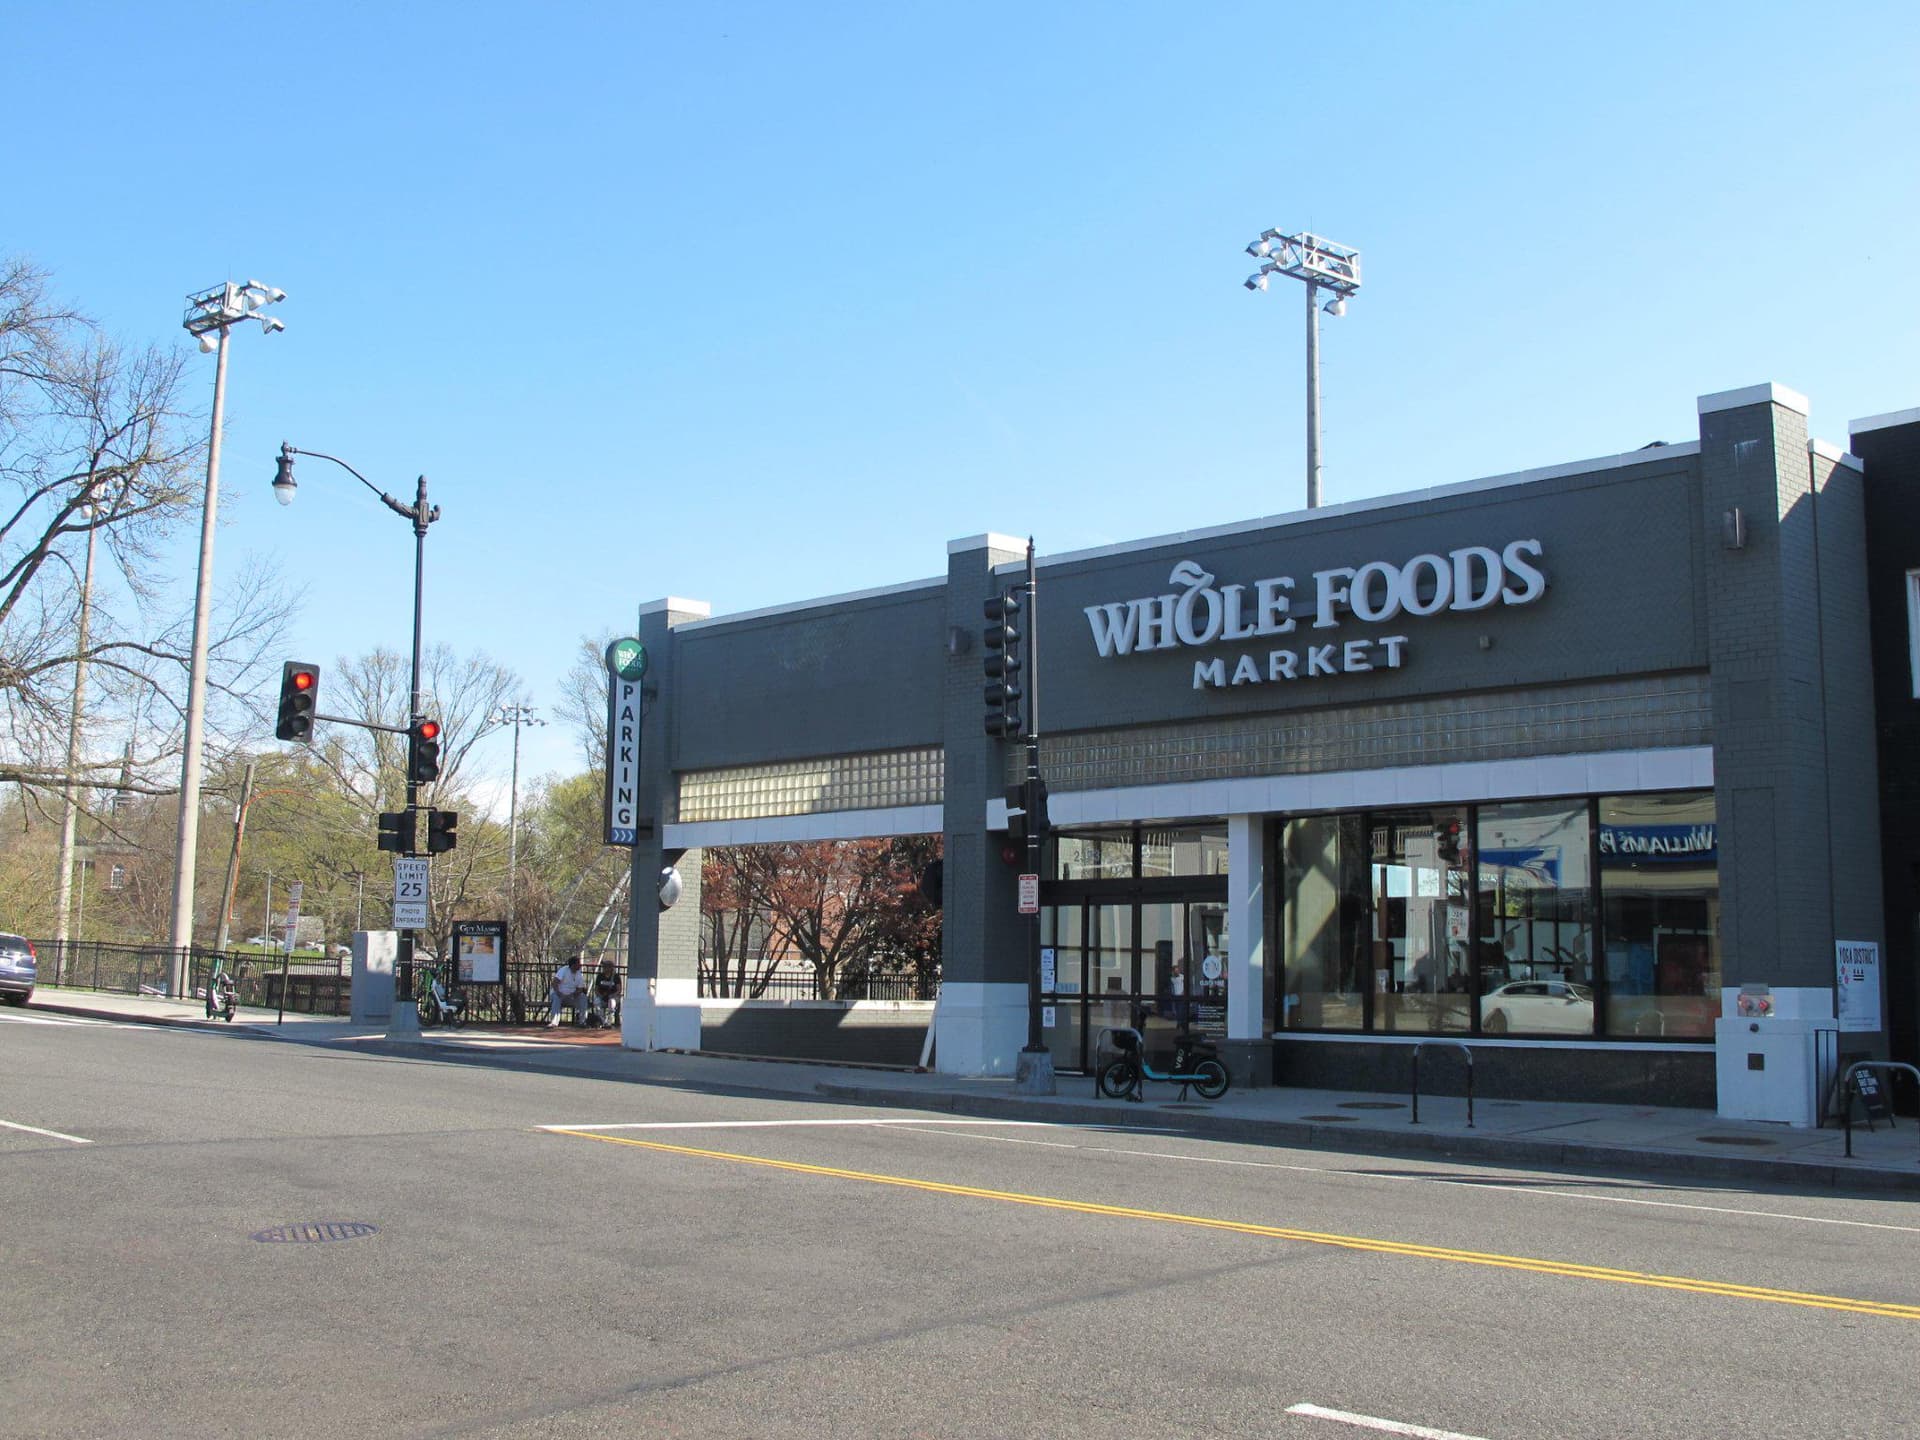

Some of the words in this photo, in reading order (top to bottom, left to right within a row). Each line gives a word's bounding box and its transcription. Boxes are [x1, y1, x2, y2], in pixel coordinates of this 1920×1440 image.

[1083, 561, 1296, 658] WHOLE
[1312, 538, 1547, 629] FOODS
[1193, 635, 1409, 690] MARKET
[618, 684, 634, 825] PARKING
[397, 863, 427, 871] SPEED
[399, 872, 424, 880] LIMIT
[400, 882, 422, 897] 25
[395, 916, 425, 924] ENFORCED
[1839, 947, 1853, 964] YOGA
[1853, 948, 1876, 965] DISTRICT
